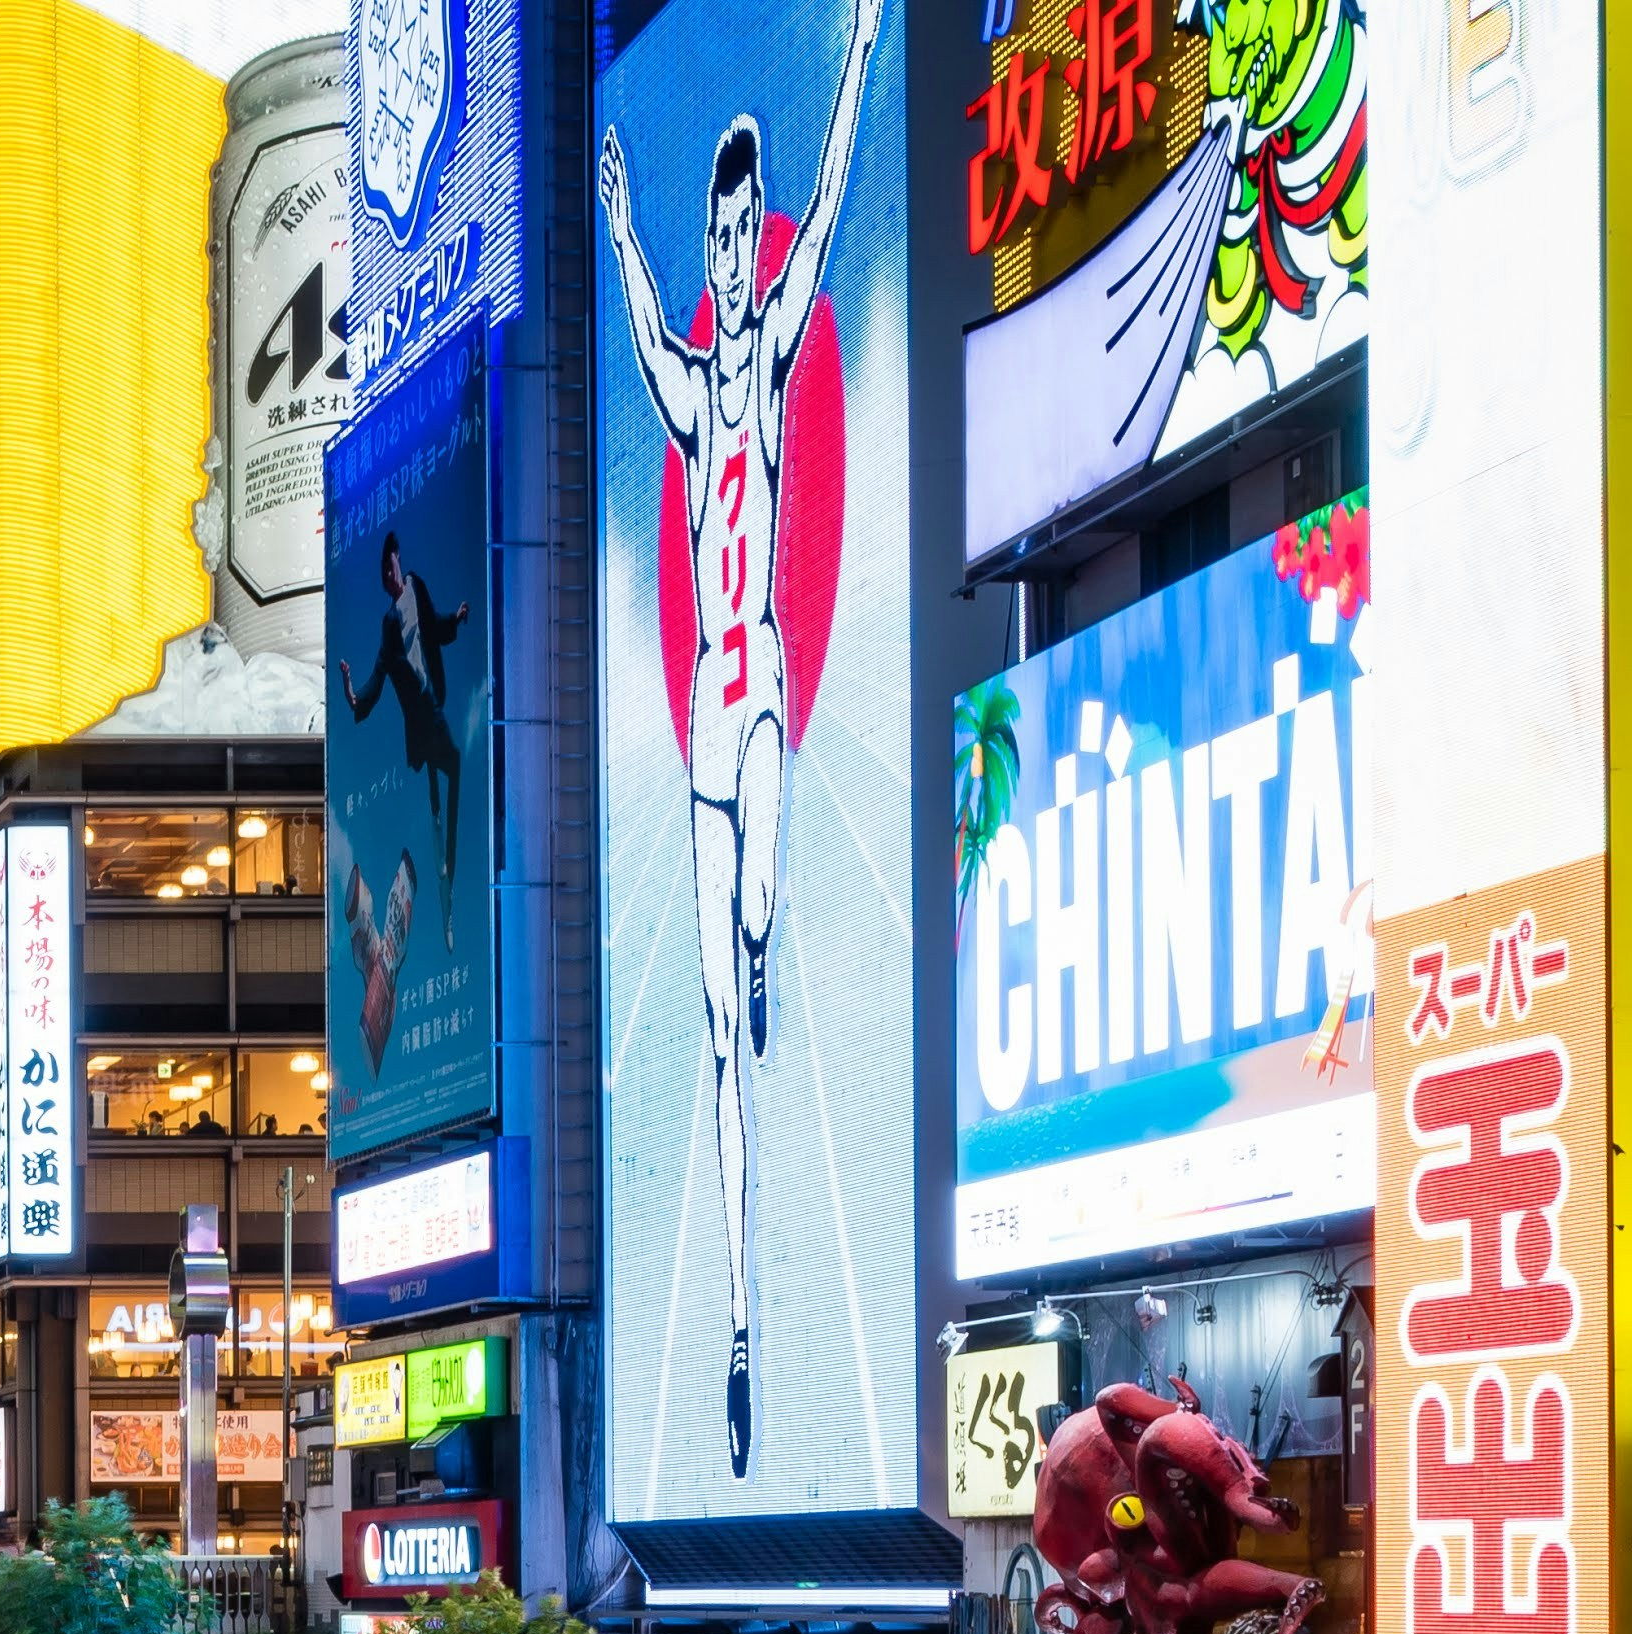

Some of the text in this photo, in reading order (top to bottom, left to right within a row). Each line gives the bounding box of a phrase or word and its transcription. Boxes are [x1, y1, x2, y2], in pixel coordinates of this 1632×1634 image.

[280, 181, 327, 235] ASAHI
[346, 225, 470, 387] 雪印メグミルク
[245, 453, 270, 472] ASAHI
[271, 442, 304, 460] SUPER
[245, 493, 264, 507] AND
[280, 454, 309, 469] USING
[718, 429, 749, 709] グリコ
[22, 895, 56, 1031] 本場の味
[1408, 908, 1571, 1043] スーパー
[968, 1371, 1036, 1490] くくる
[384, 1525, 471, 1576] LOTTERIA
